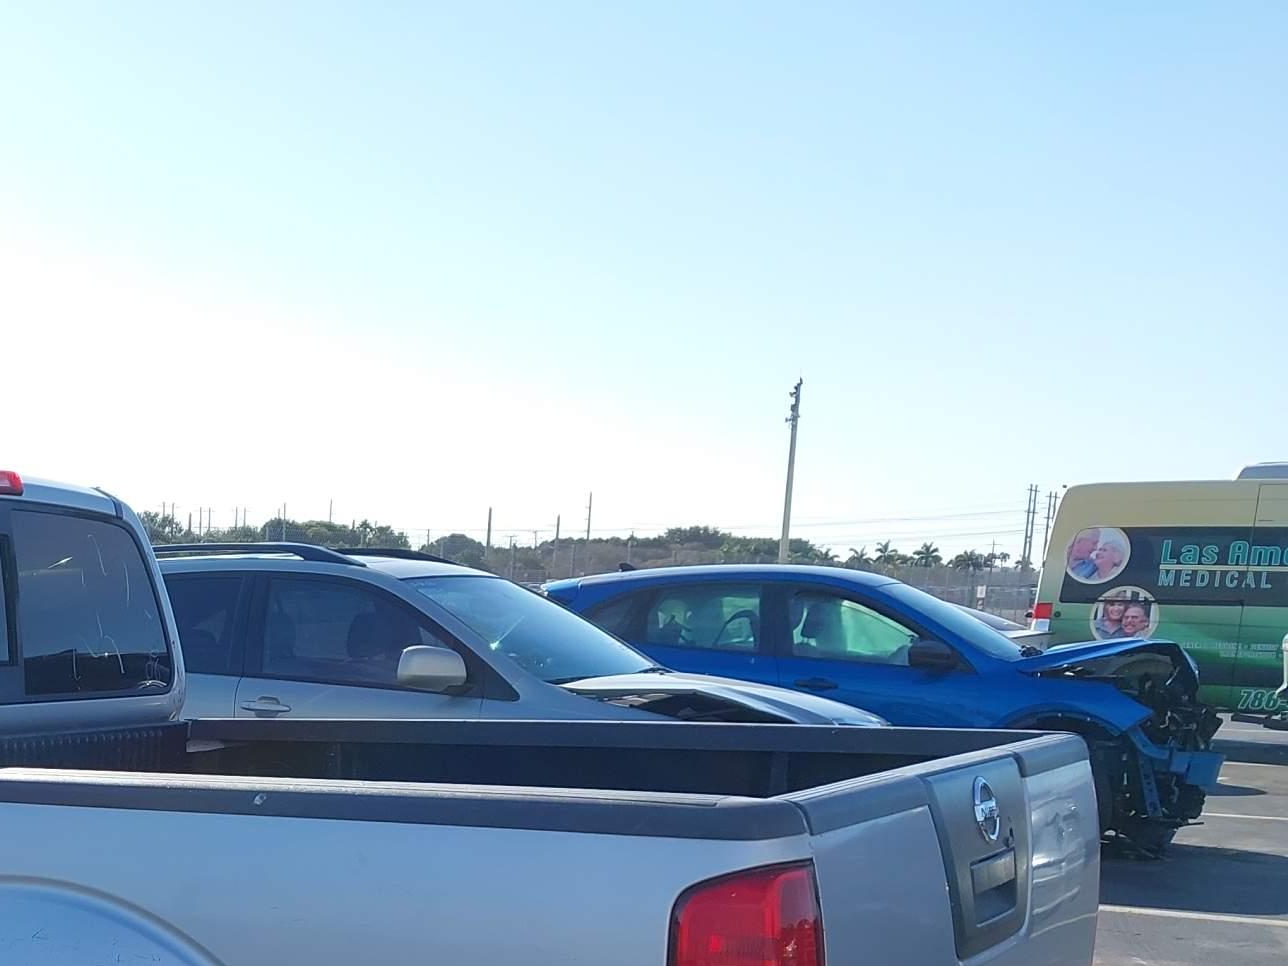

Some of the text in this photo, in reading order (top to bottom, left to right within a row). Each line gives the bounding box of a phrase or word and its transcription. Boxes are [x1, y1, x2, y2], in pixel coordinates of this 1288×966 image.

[1160, 539, 1288, 566] Las Am
[1157, 569, 1272, 589] MEDICAL
